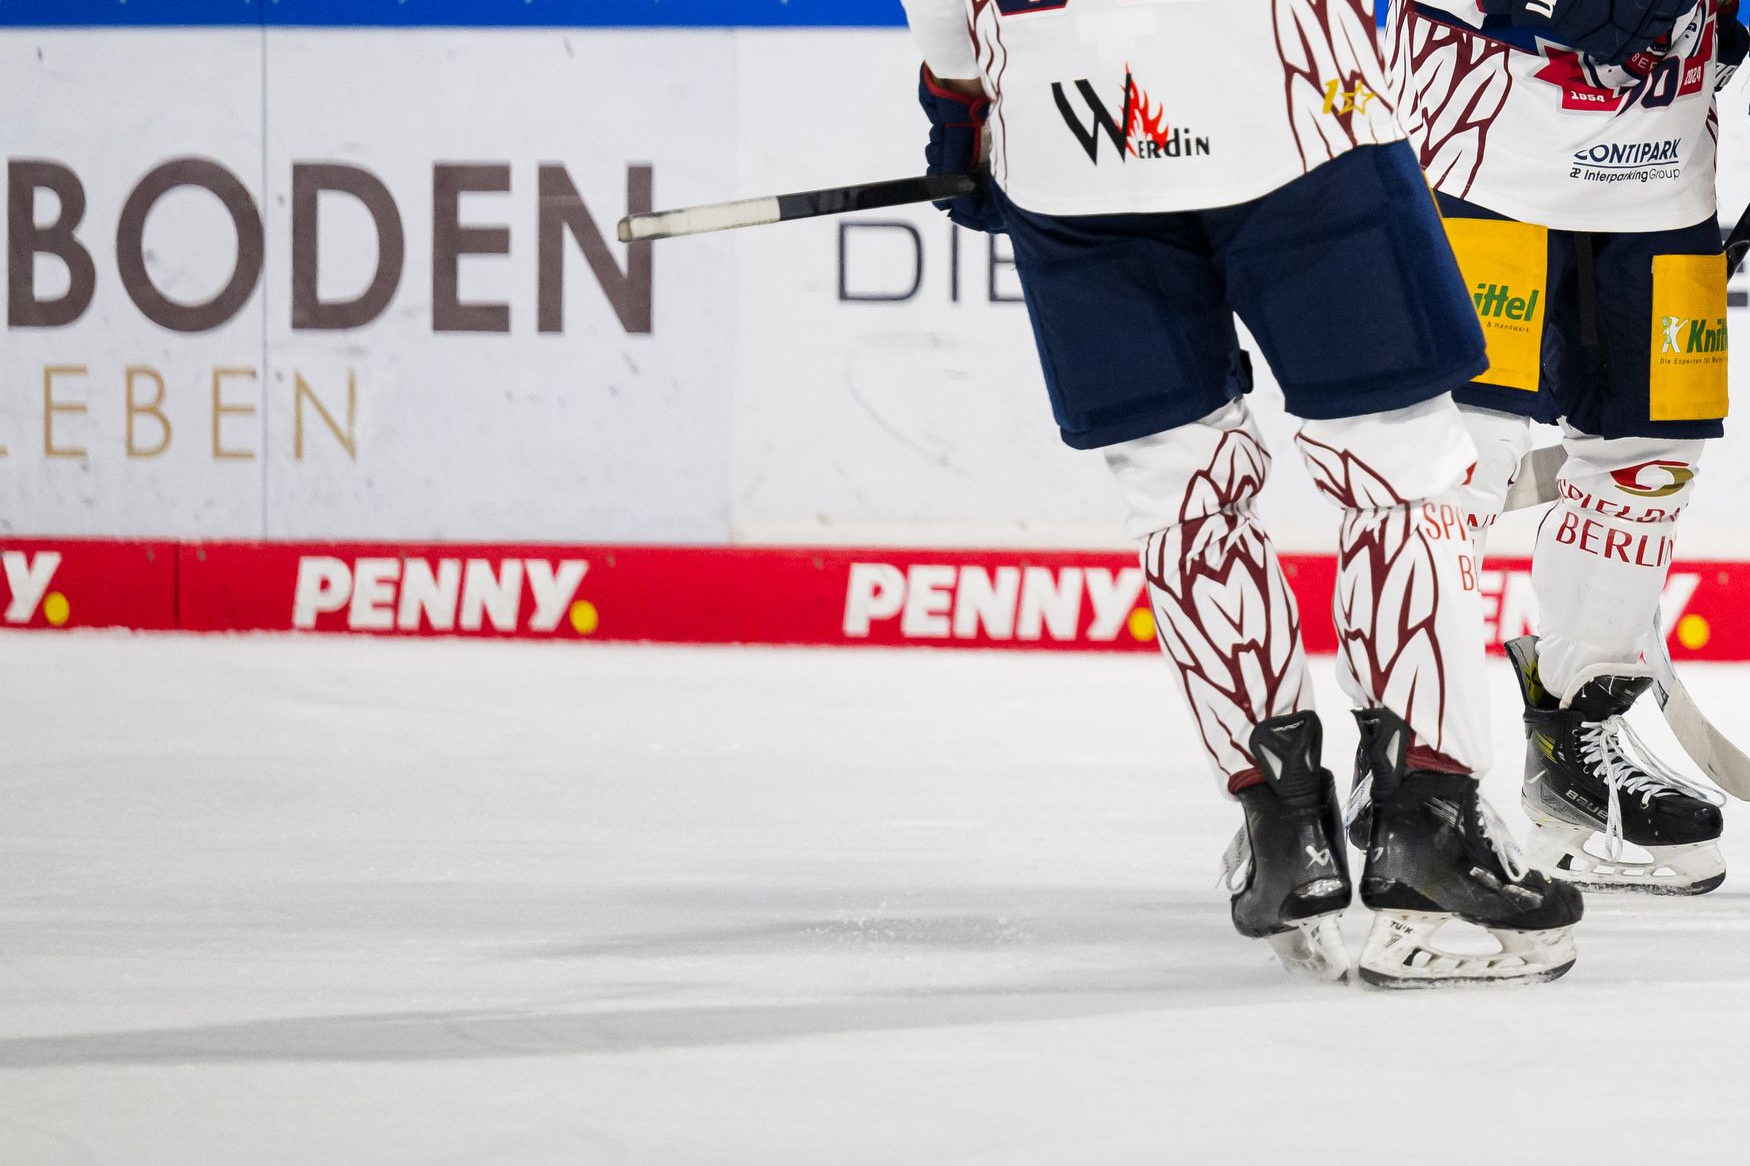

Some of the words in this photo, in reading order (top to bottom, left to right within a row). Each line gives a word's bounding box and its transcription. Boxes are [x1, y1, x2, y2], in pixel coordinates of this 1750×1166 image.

[1570, 90, 1605, 103] 1954
[1573, 138, 1682, 164] CONTIPARK
[7, 155, 654, 336] BODEN
[0, 366, 359, 462] EBEN
[1565, 789, 1609, 820] BAUE
